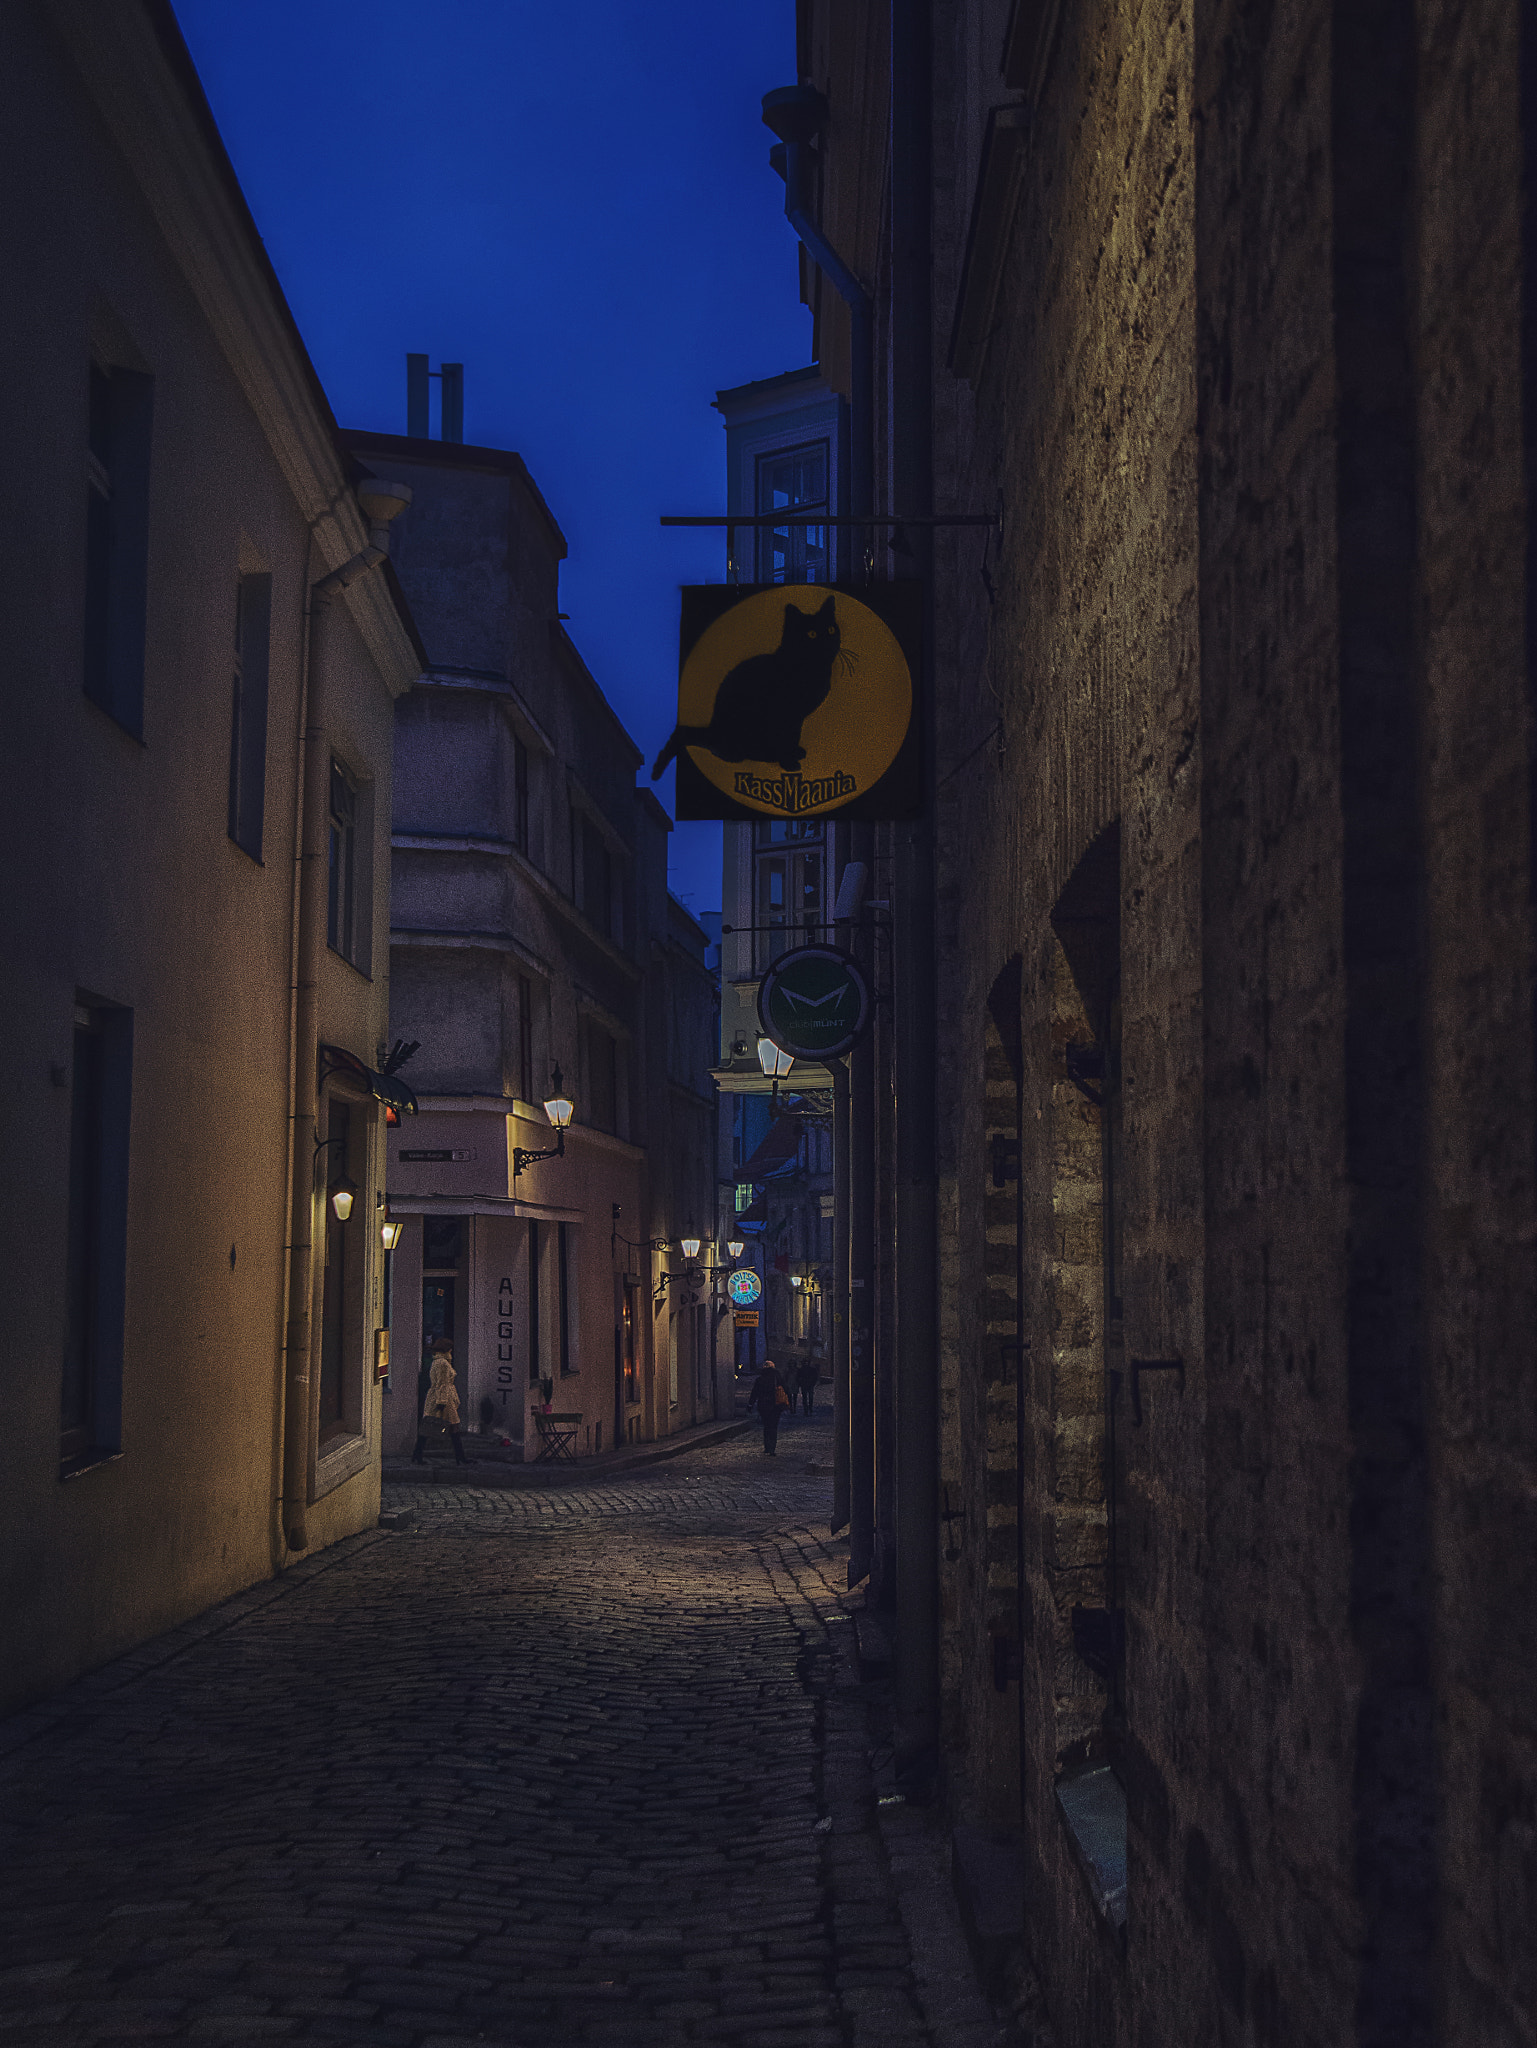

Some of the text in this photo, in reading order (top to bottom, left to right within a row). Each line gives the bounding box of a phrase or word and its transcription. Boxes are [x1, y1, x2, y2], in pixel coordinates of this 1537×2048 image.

[736, 771, 856, 812] KassMaania
[458, 1151, 465, 1159] 5
[496, 1277, 513, 1405] AUGUST
